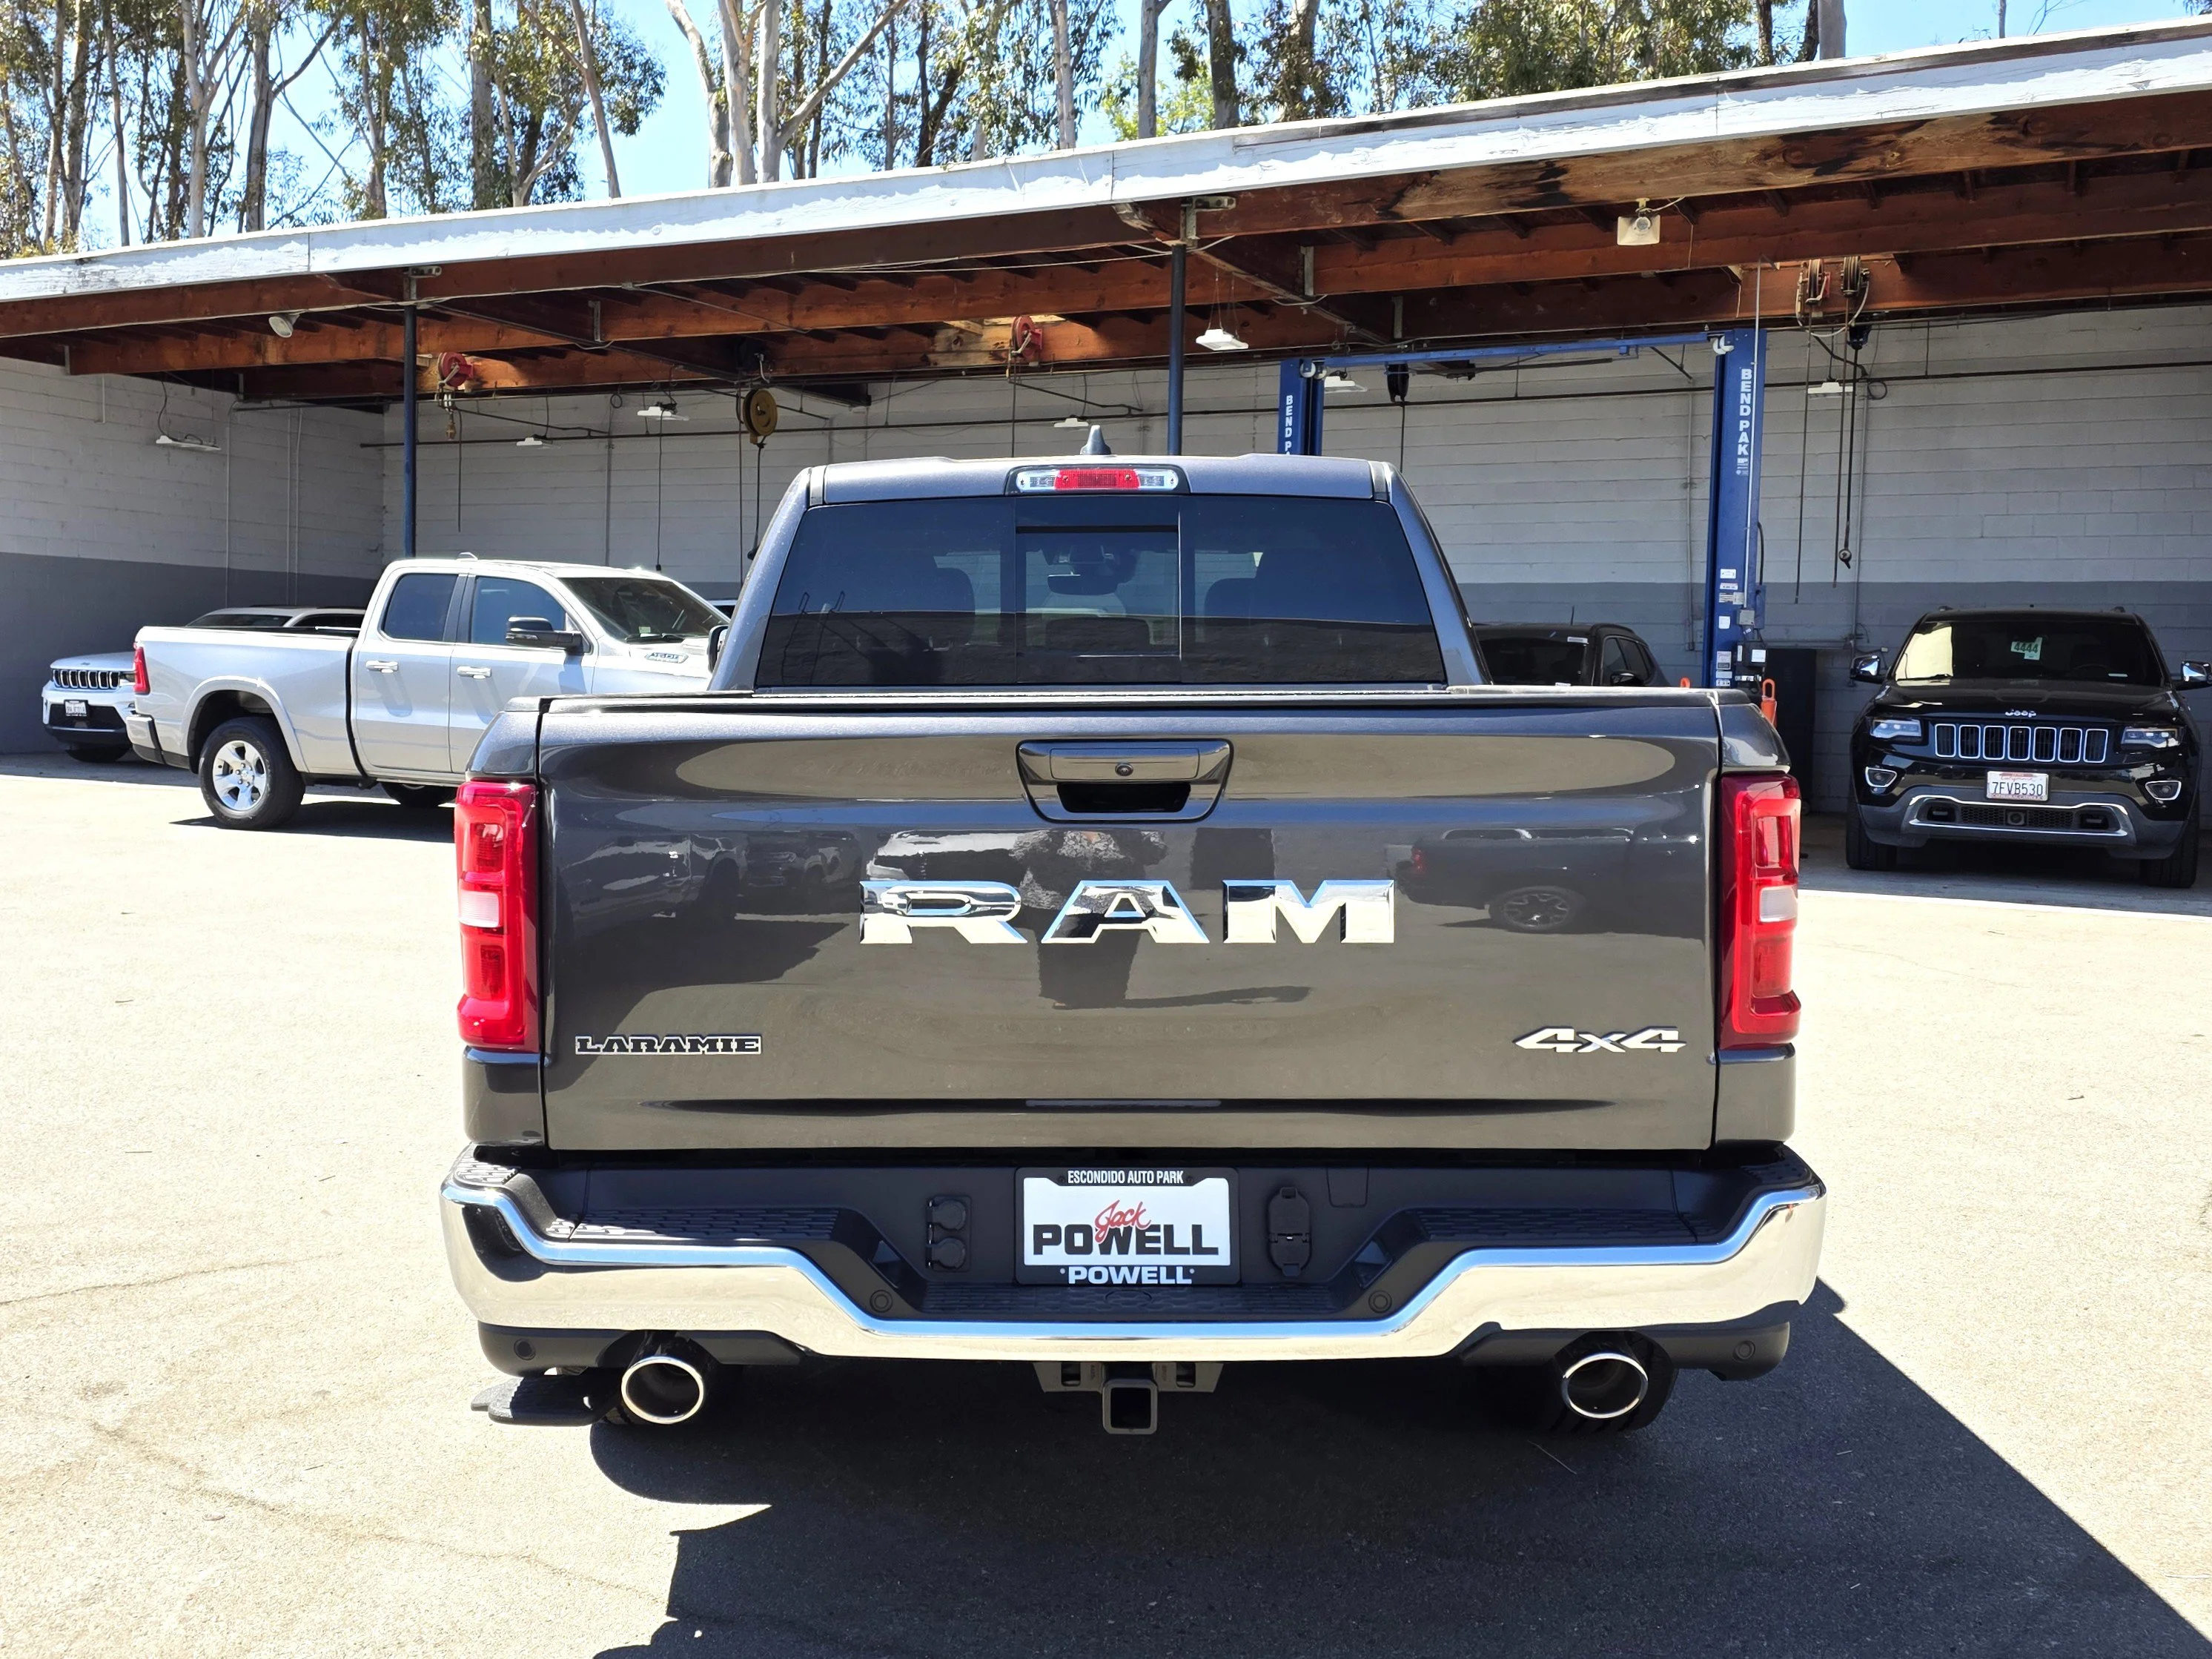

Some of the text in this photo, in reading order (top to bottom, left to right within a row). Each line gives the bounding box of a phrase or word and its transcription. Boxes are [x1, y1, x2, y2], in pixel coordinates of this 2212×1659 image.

[1740, 368, 1752, 417] BEND
[1285, 394, 1294, 438] BEND
[1737, 420, 1750, 455] PAK
[2014, 641, 2039, 653] 4444
[2004, 709, 2037, 718] Jeep
[1992, 781, 2044, 796] 7FVB530
[860, 880, 1395, 944] RAM
[575, 1036, 762, 1056] LARAMIE
[1067, 1170, 1184, 1185] ESCONDIDO AUTO PARK
[1094, 1199, 1151, 1243] Jack
[1033, 1224, 1219, 1255] POWELL
[1068, 1266, 1193, 1285] POWELL
